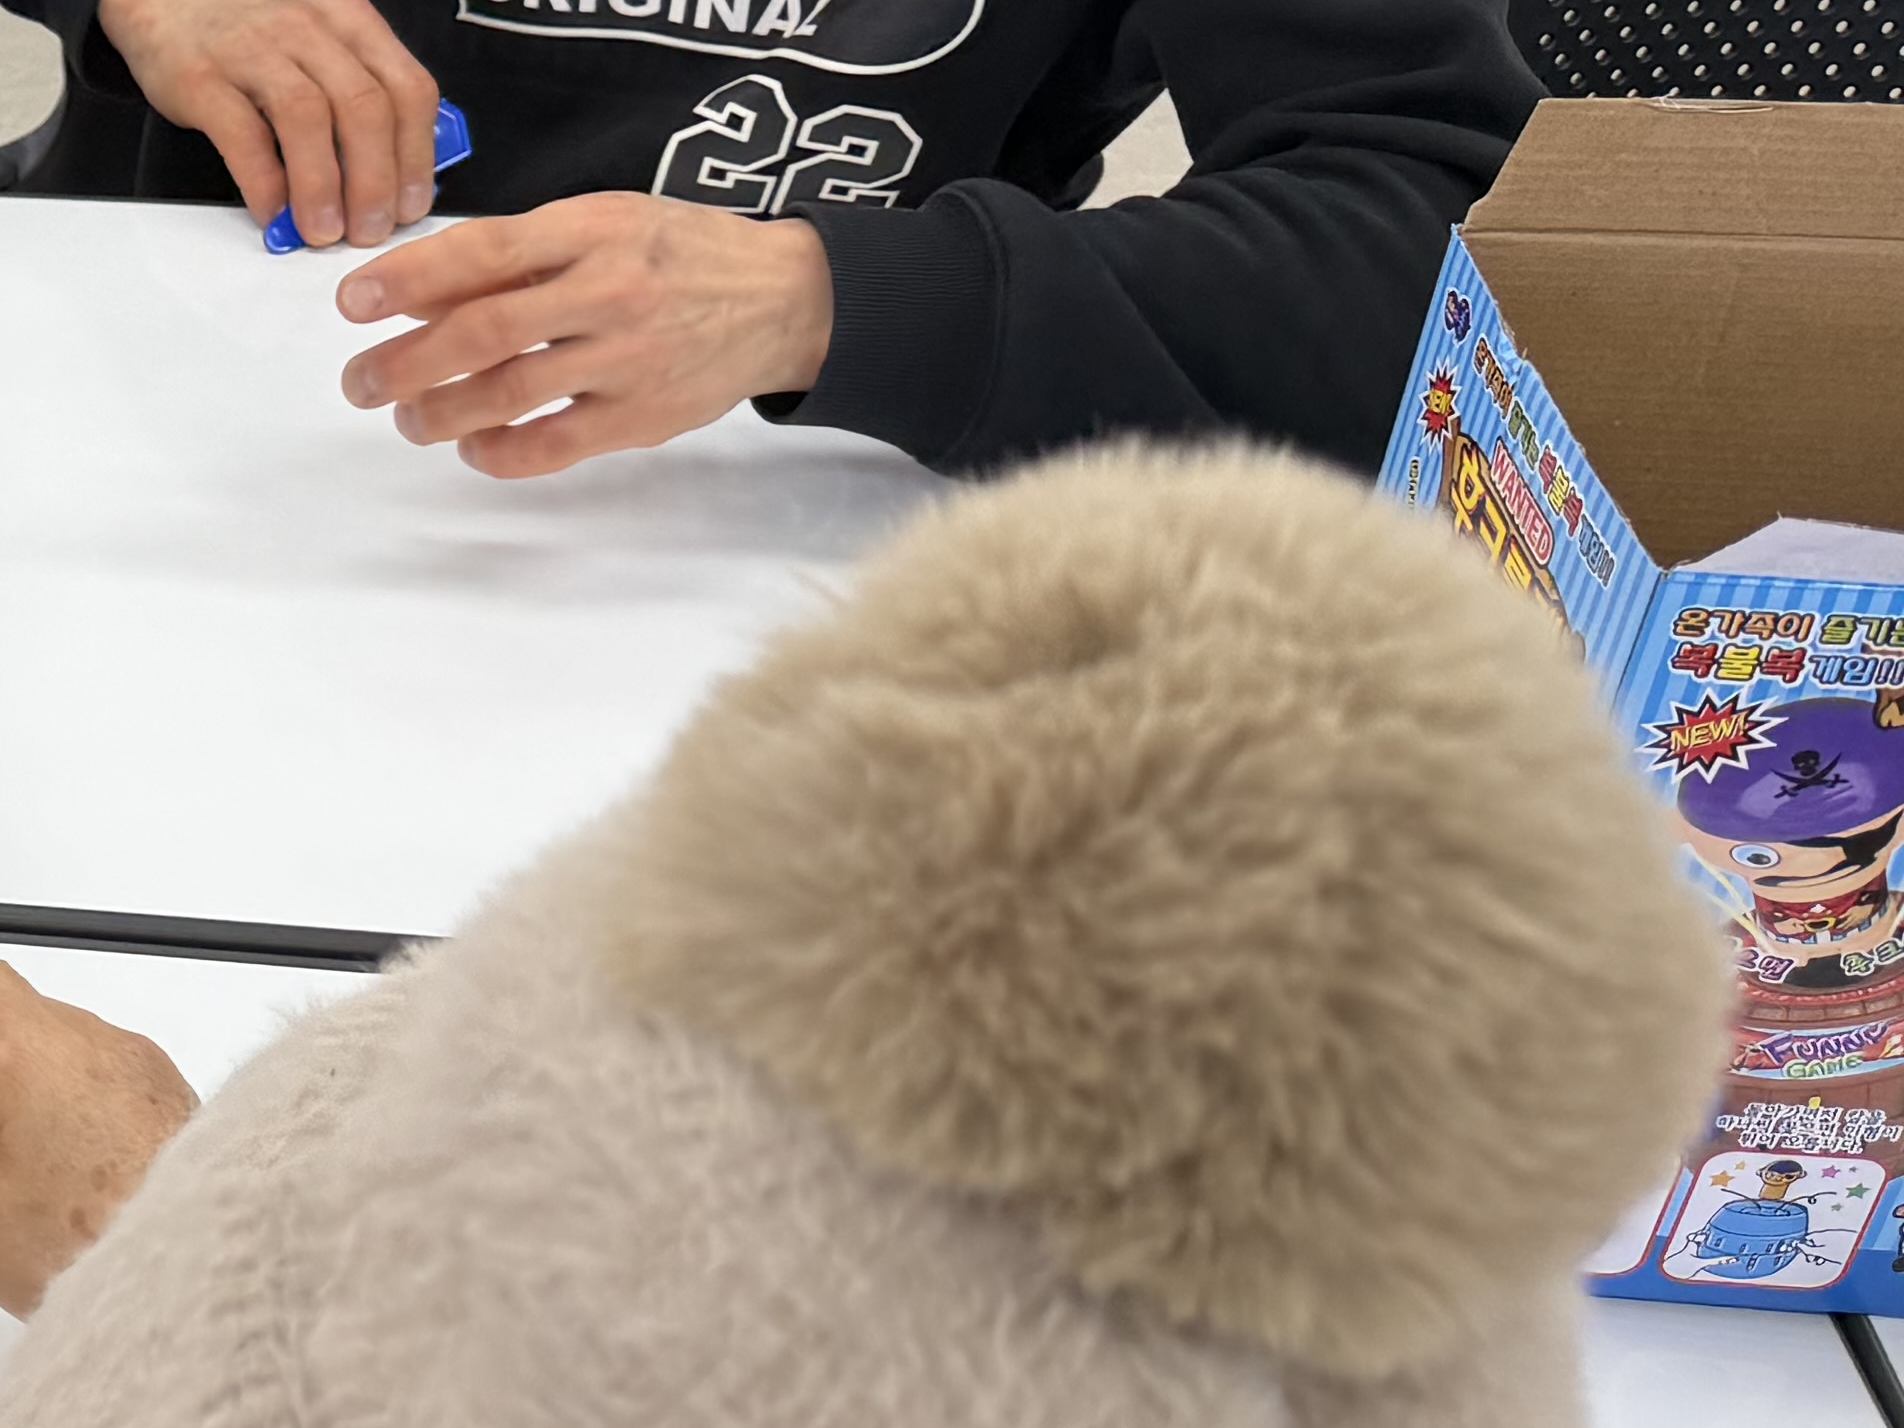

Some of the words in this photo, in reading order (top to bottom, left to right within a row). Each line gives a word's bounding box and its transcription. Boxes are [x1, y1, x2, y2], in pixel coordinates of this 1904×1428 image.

[650, 74, 923, 214] 22
[1491, 442, 1553, 567] WANTED
[1673, 607, 1815, 642] 온가족이
[1672, 642, 1808, 683] 복불복
[1670, 712, 1749, 752] NEW!
[1762, 1020, 1889, 1066] FUNNY
[1784, 1052, 1866, 1078] GAME
